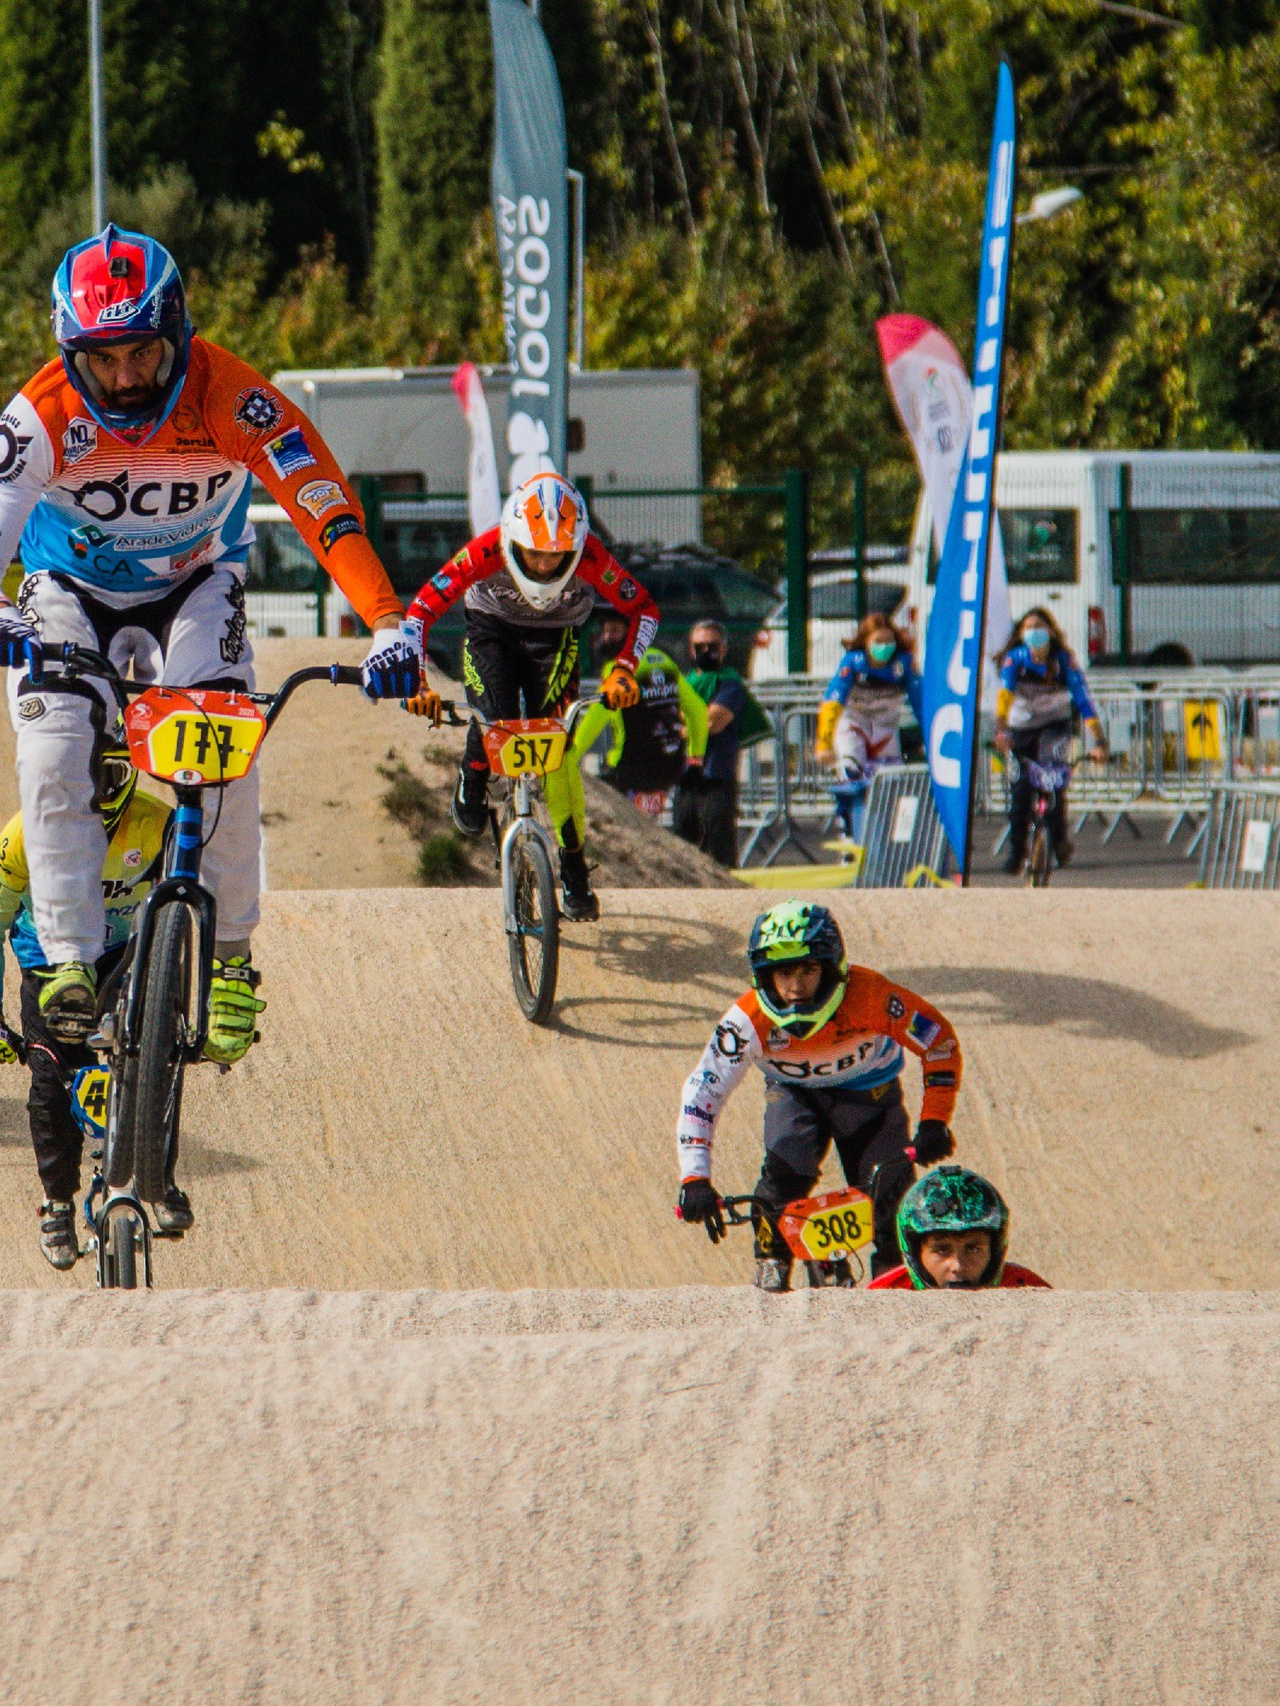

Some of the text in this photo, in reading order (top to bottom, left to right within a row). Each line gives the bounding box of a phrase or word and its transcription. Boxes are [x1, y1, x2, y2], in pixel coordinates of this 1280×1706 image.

[174, 720, 235, 769] 177
[514, 738, 554, 769] 517
[813, 1210, 862, 1248] 308
